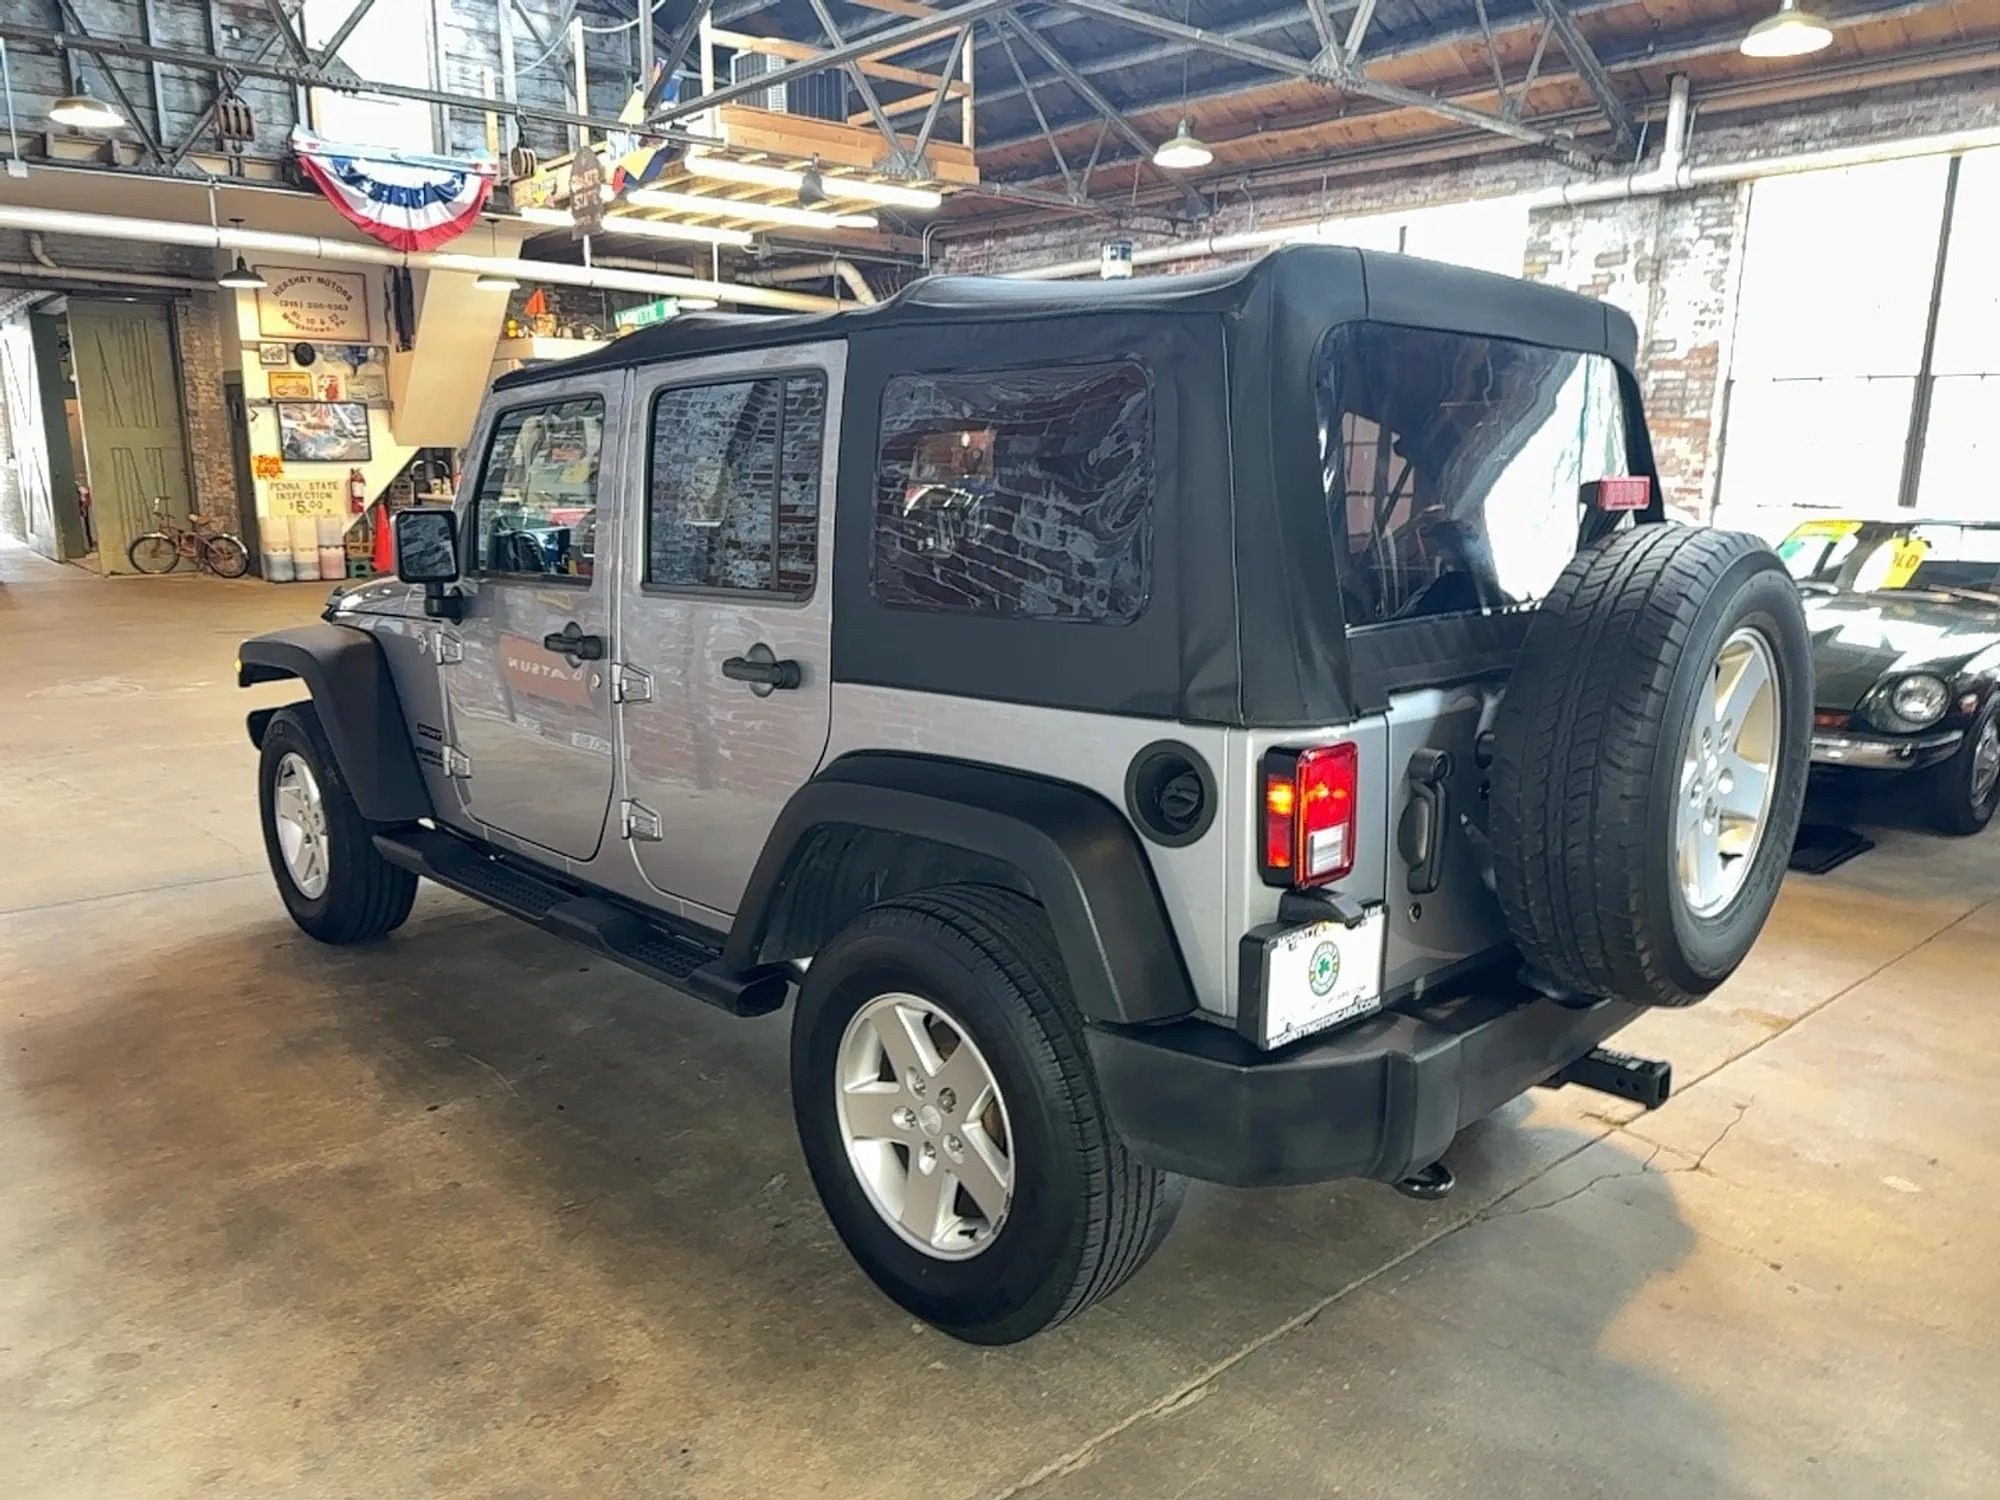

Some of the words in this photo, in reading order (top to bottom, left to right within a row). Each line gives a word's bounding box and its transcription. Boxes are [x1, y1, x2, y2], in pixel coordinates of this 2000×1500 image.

[316, 277, 353, 302] MOTORS
[309, 481, 339, 491] STATE
[276, 491, 333, 501] INSPECTION
